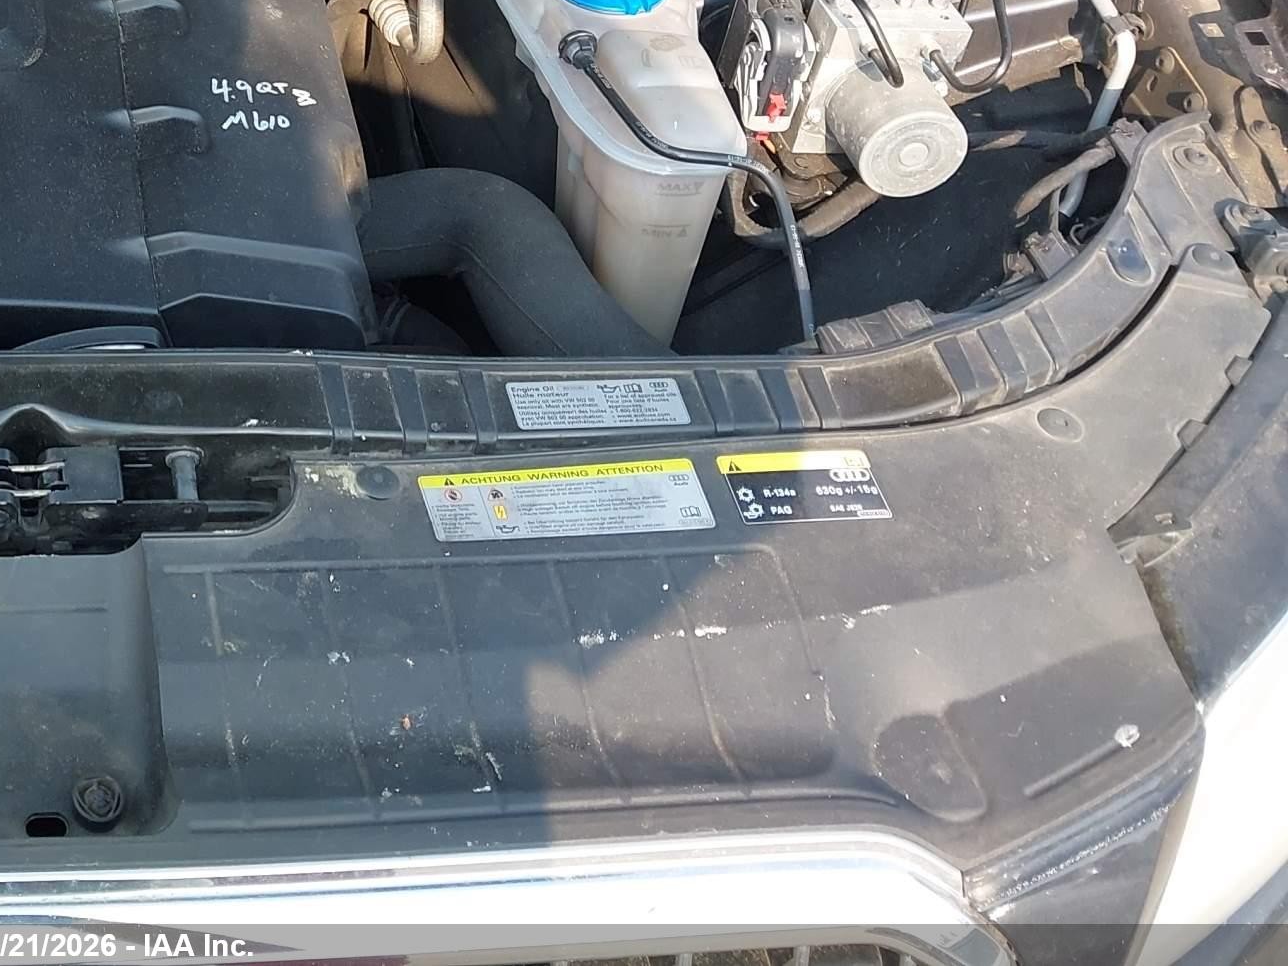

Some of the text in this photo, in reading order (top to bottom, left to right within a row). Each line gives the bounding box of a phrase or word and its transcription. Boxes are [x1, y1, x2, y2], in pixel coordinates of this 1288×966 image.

[510, 386, 540, 394] Engine
[461, 474, 521, 485] ACHTUNG
[527, 469, 590, 481] WARNING
[596, 464, 664, 476] ATTENTION
[763, 488, 796, 498] R-134a
[770, 505, 793, 515] PAG
